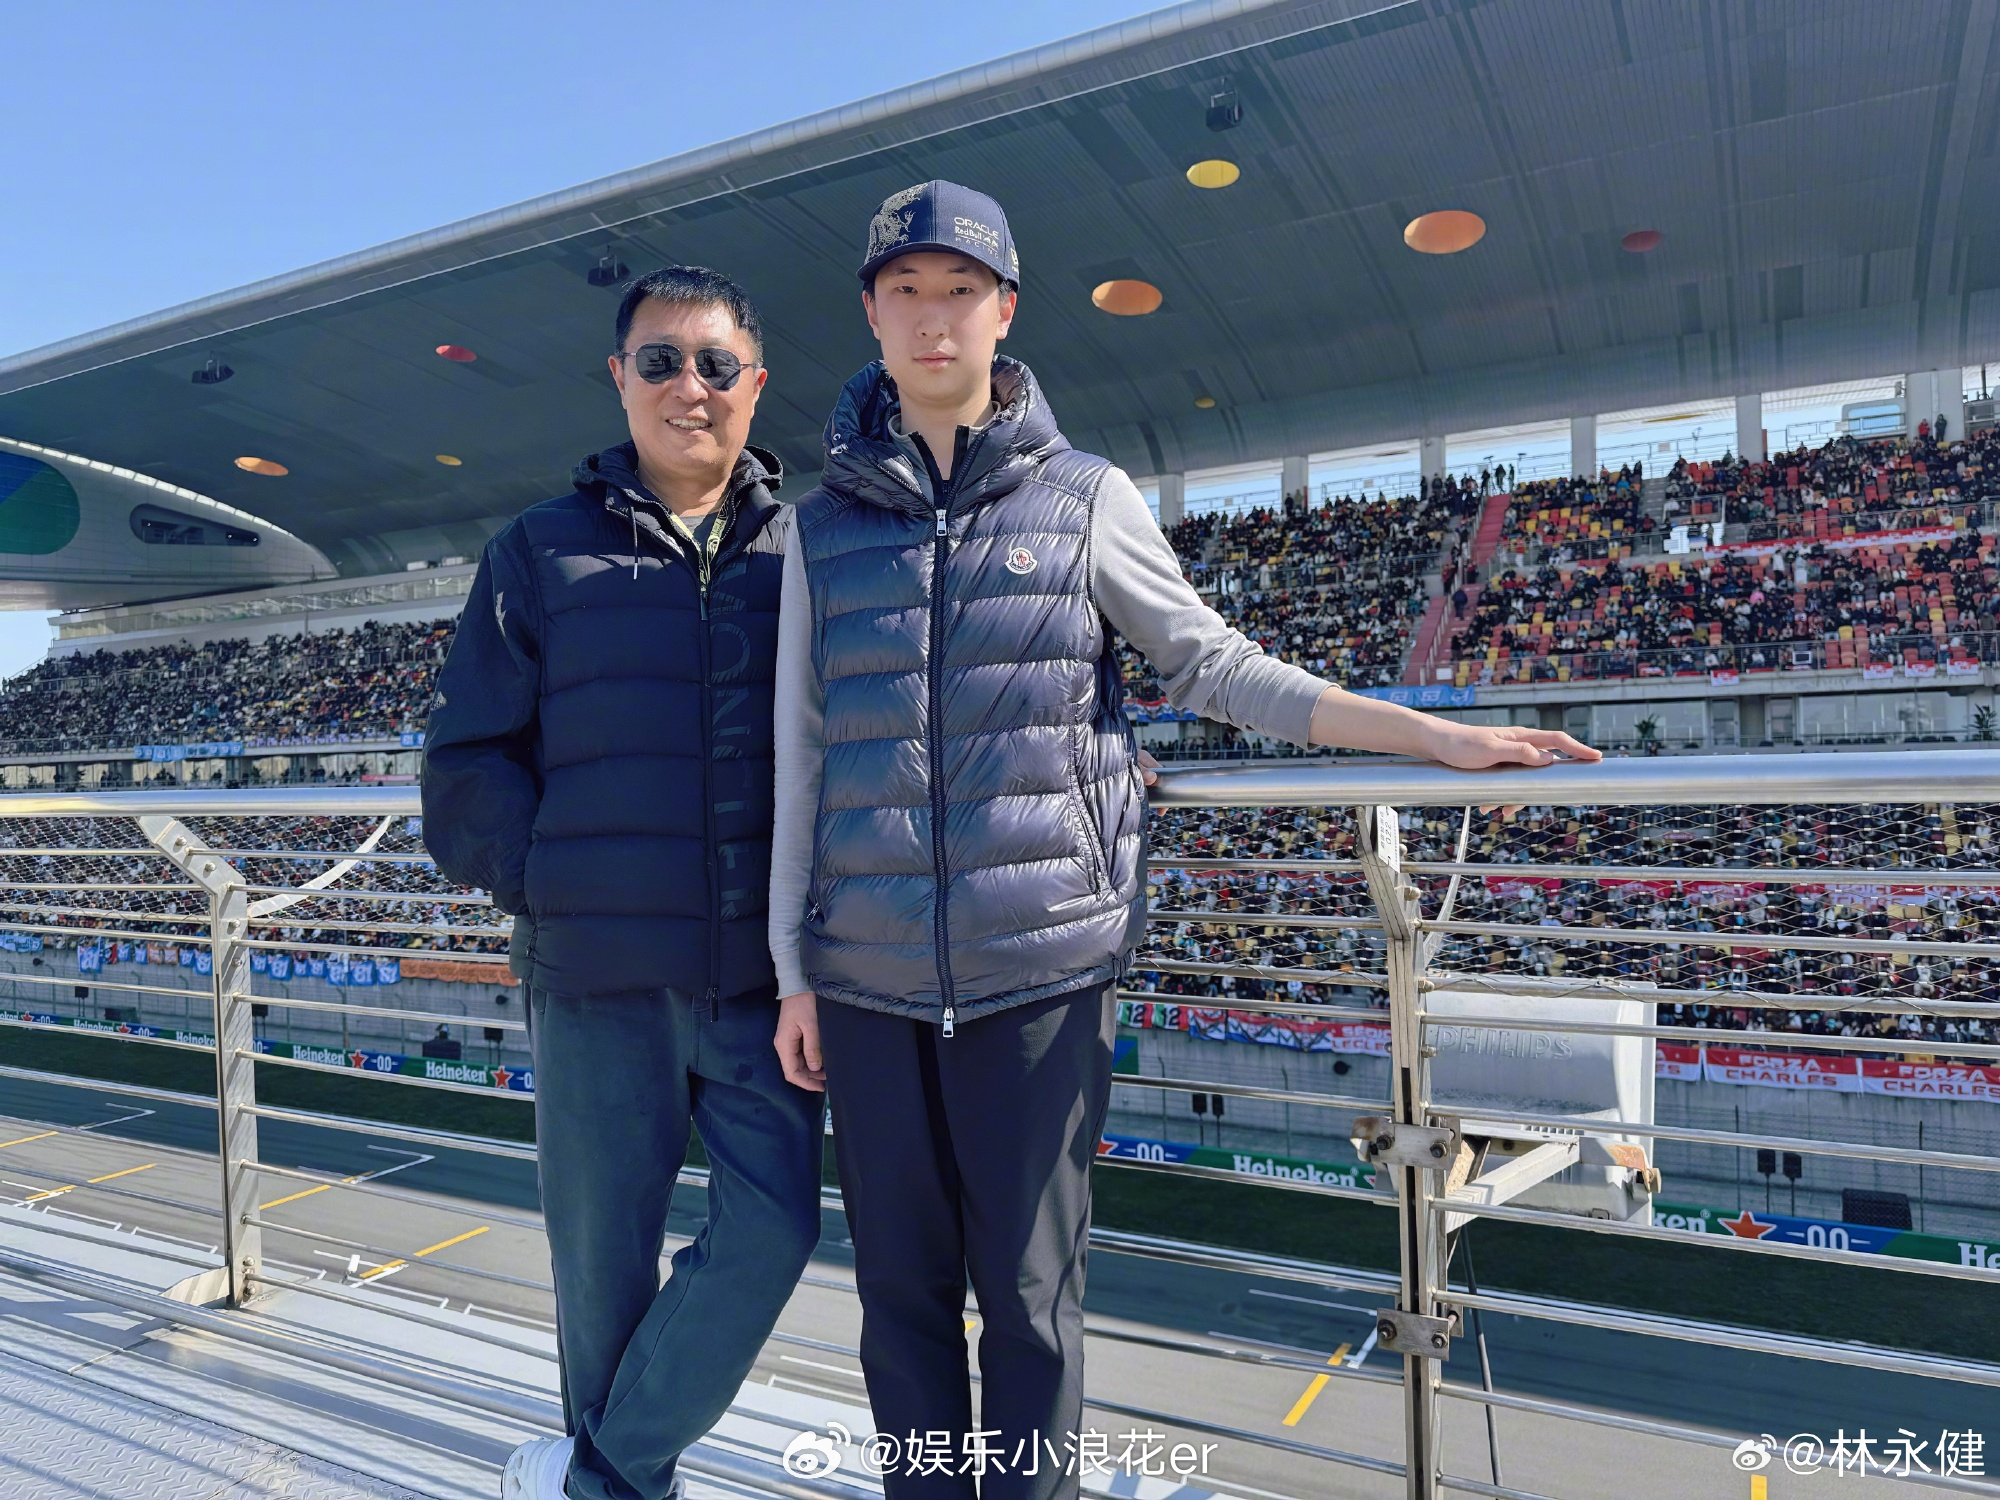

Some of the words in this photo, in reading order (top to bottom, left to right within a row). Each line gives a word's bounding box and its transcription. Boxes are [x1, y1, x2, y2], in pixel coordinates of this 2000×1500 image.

[954, 217, 999, 240] ORACLE
[271, 961, 289, 977] 81
[354, 963, 373, 982] 81
[1127, 1004, 1147, 1023] 12
[1161, 1007, 1182, 1026] 12
[1436, 1025, 1574, 1061] PHILIPS
[292, 1045, 346, 1066] Heineken
[1738, 1054, 1821, 1072] FORZA
[425, 1060, 488, 1085] Heineken
[1725, 1069, 1838, 1087] CHARLES
[1898, 1065, 1988, 1082] FORZA
[1883, 1080, 2000, 1098] CHARLES
[1232, 1154, 1359, 1188] Heineken
